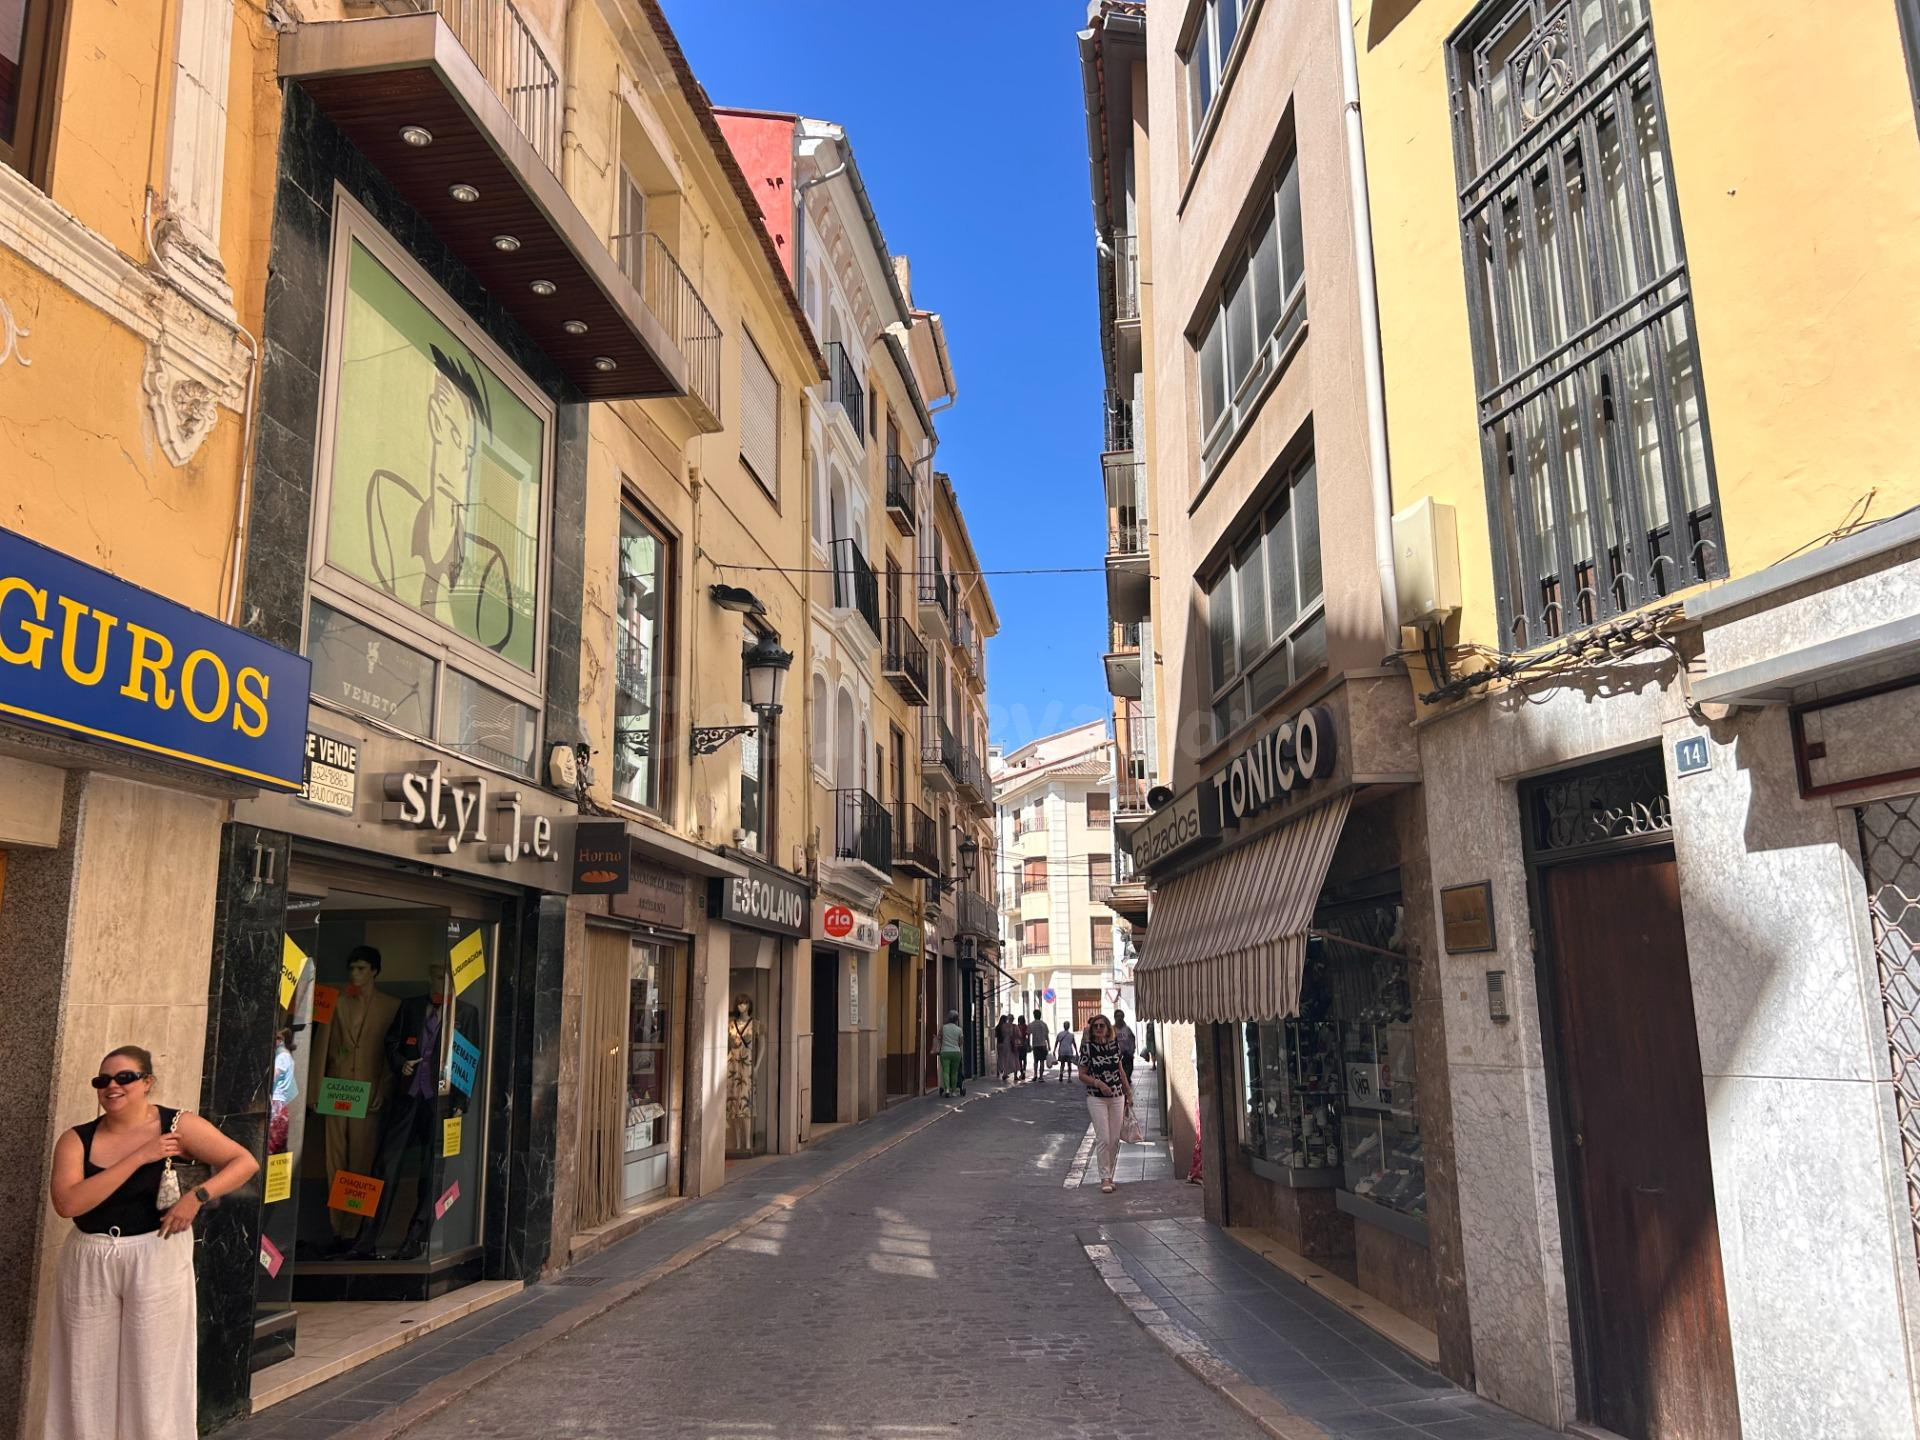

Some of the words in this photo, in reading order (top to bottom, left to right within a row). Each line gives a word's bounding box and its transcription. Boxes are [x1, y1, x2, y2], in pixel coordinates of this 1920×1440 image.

[0, 577, 271, 738] GUROS
[342, 681, 399, 716] VENETO
[304, 733, 316, 758] E
[319, 736, 357, 770] VENDE
[1683, 744, 1701, 768] 14
[1213, 706, 1318, 829] TONICO
[1134, 805, 1199, 870] calzados
[252, 843, 275, 883] 11
[578, 847, 622, 864] Horno
[731, 877, 802, 928] ESCOLANO
[827, 910, 851, 926] ria
[452, 949, 483, 976] LIQUIDACIÓN
[452, 1042, 478, 1067] REMATE
[450, 1061, 470, 1082] FINAL
[326, 1082, 365, 1094] CAZADORA
[327, 1092, 361, 1103] INVIERNO
[339, 1176, 376, 1192] CHAQUETA
